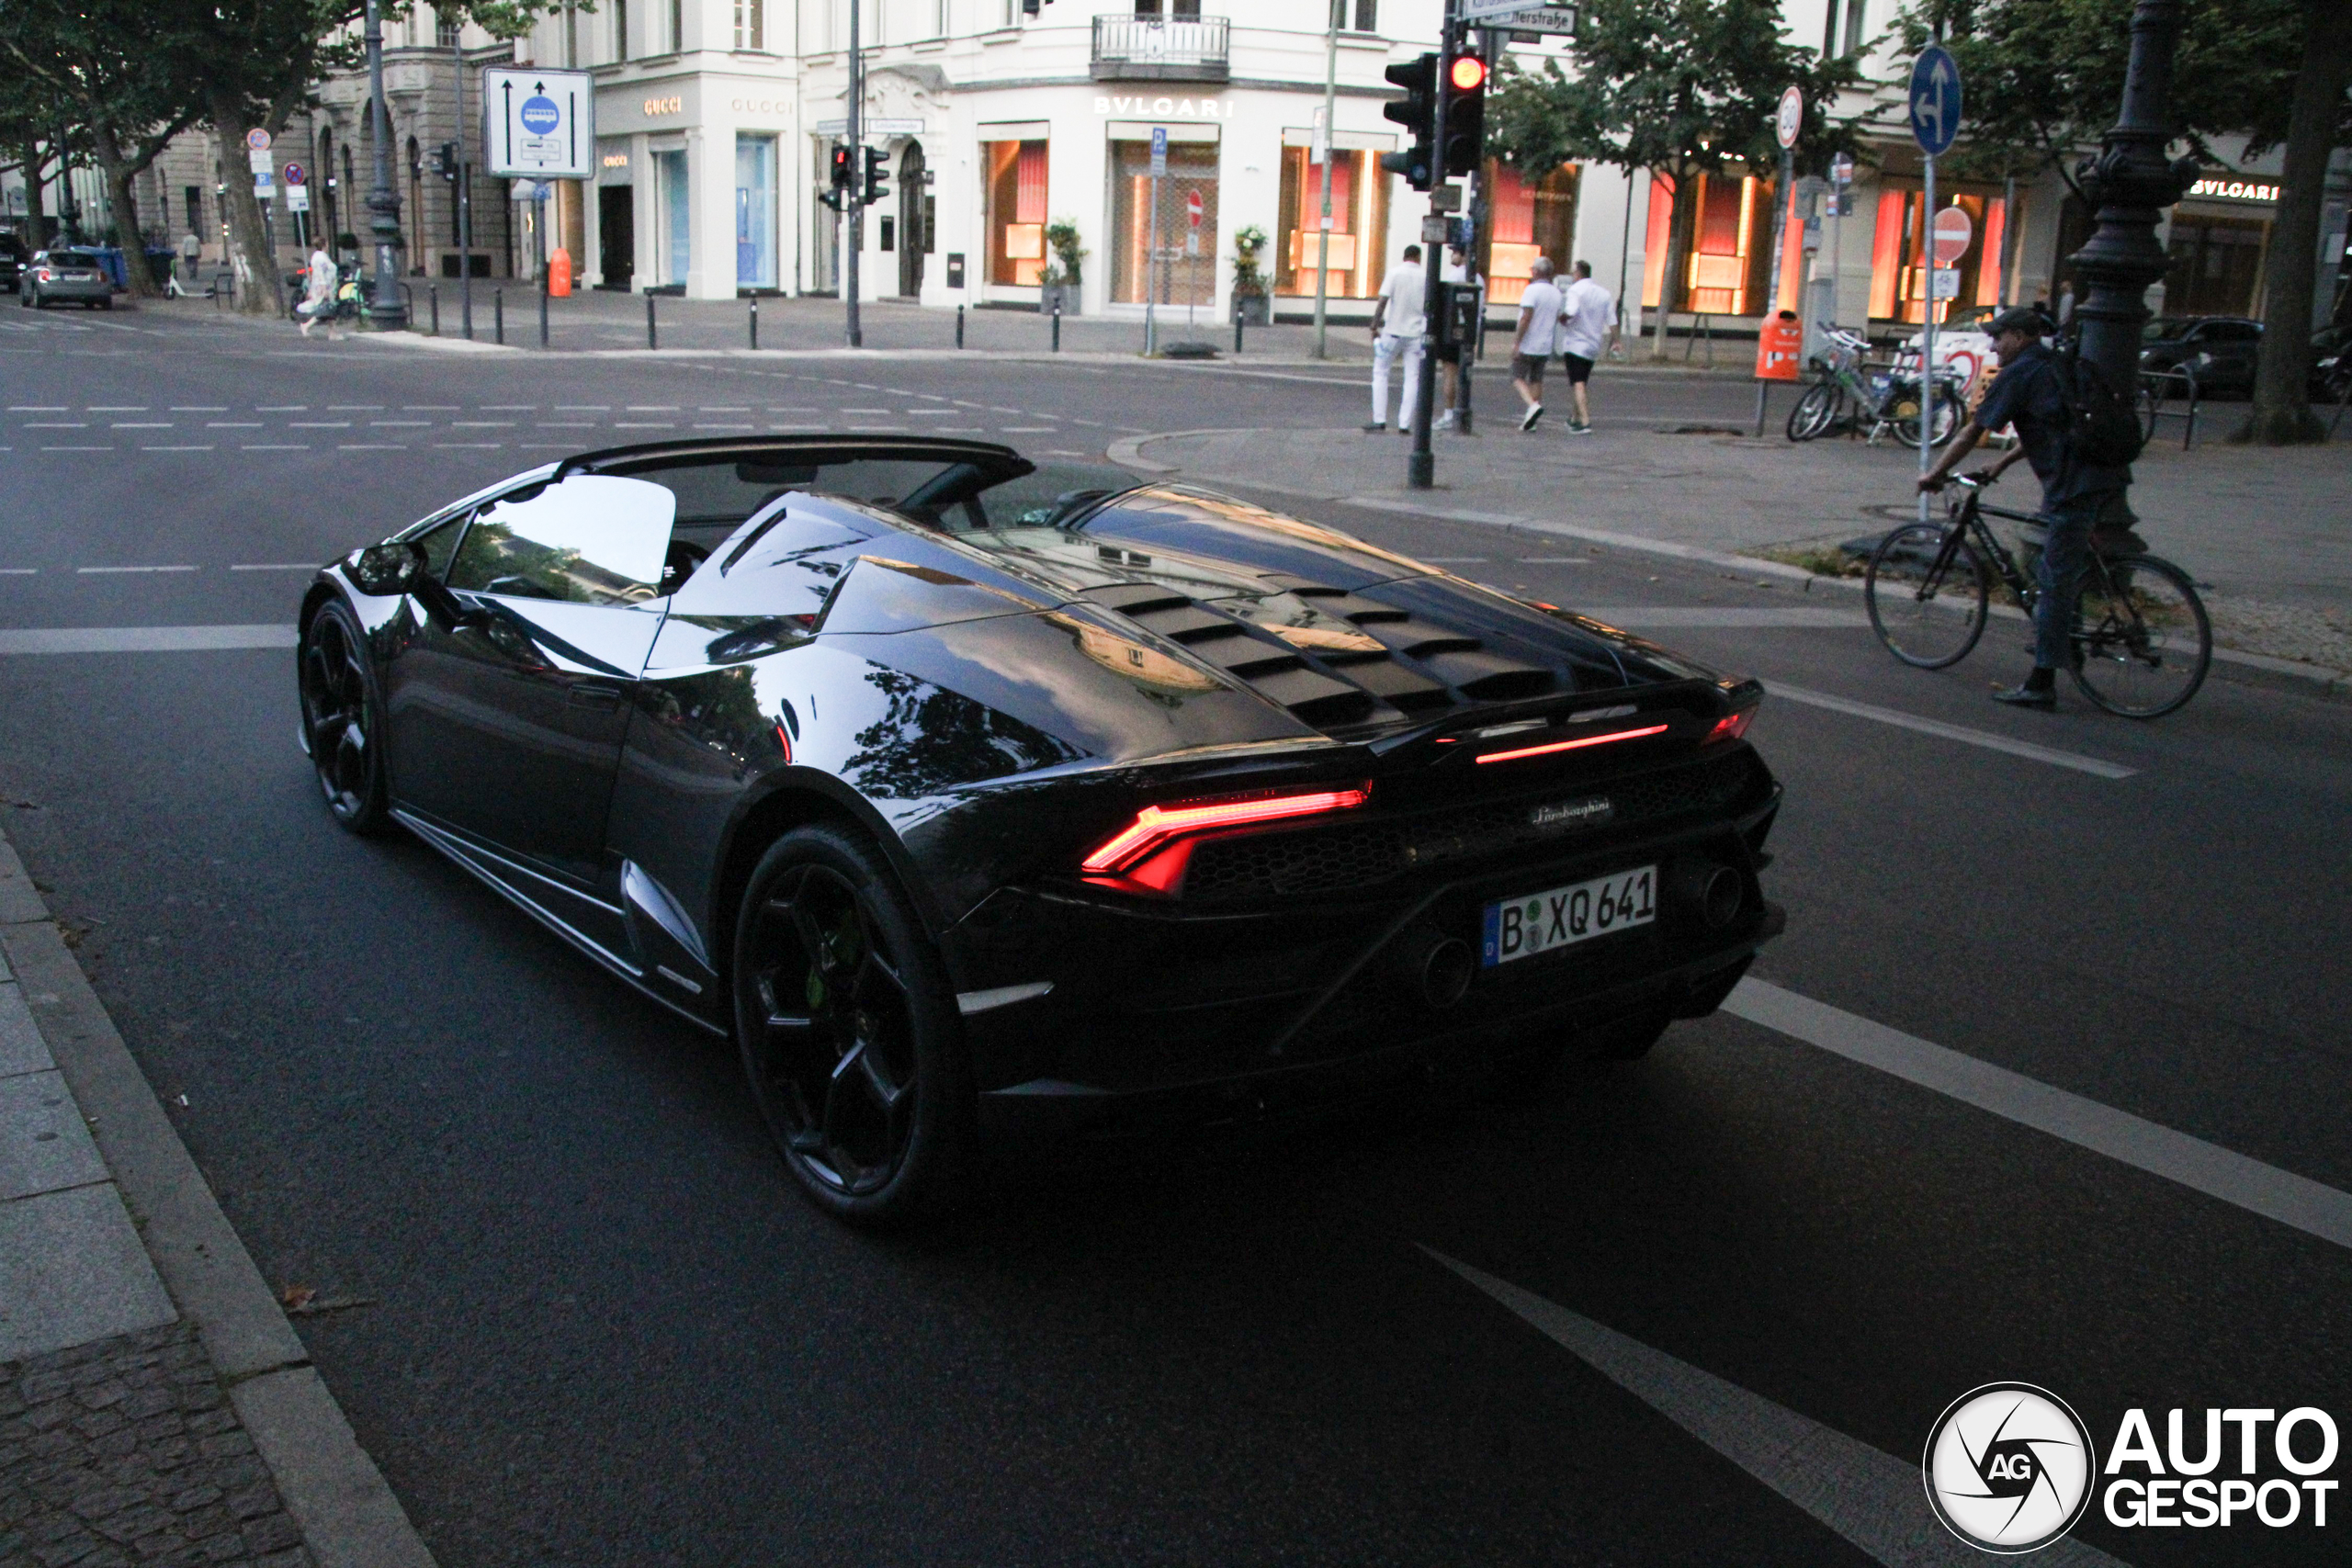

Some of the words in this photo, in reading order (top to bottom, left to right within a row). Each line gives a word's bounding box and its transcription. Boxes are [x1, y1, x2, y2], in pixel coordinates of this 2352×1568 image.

[644, 96, 682, 116] GUCCI
[731, 97, 793, 115] GUCCI
[1094, 96, 1234, 118] BVLGARI
[604, 155, 628, 167] GUCCI
[2189, 179, 2279, 200] BVLGARI
[1533, 798, 1610, 825] Lamborghini
[1501, 906, 1522, 955] B
[1547, 888, 1590, 944] XQ
[1598, 872, 1654, 929] 641
[1485, 942, 1494, 956] D
